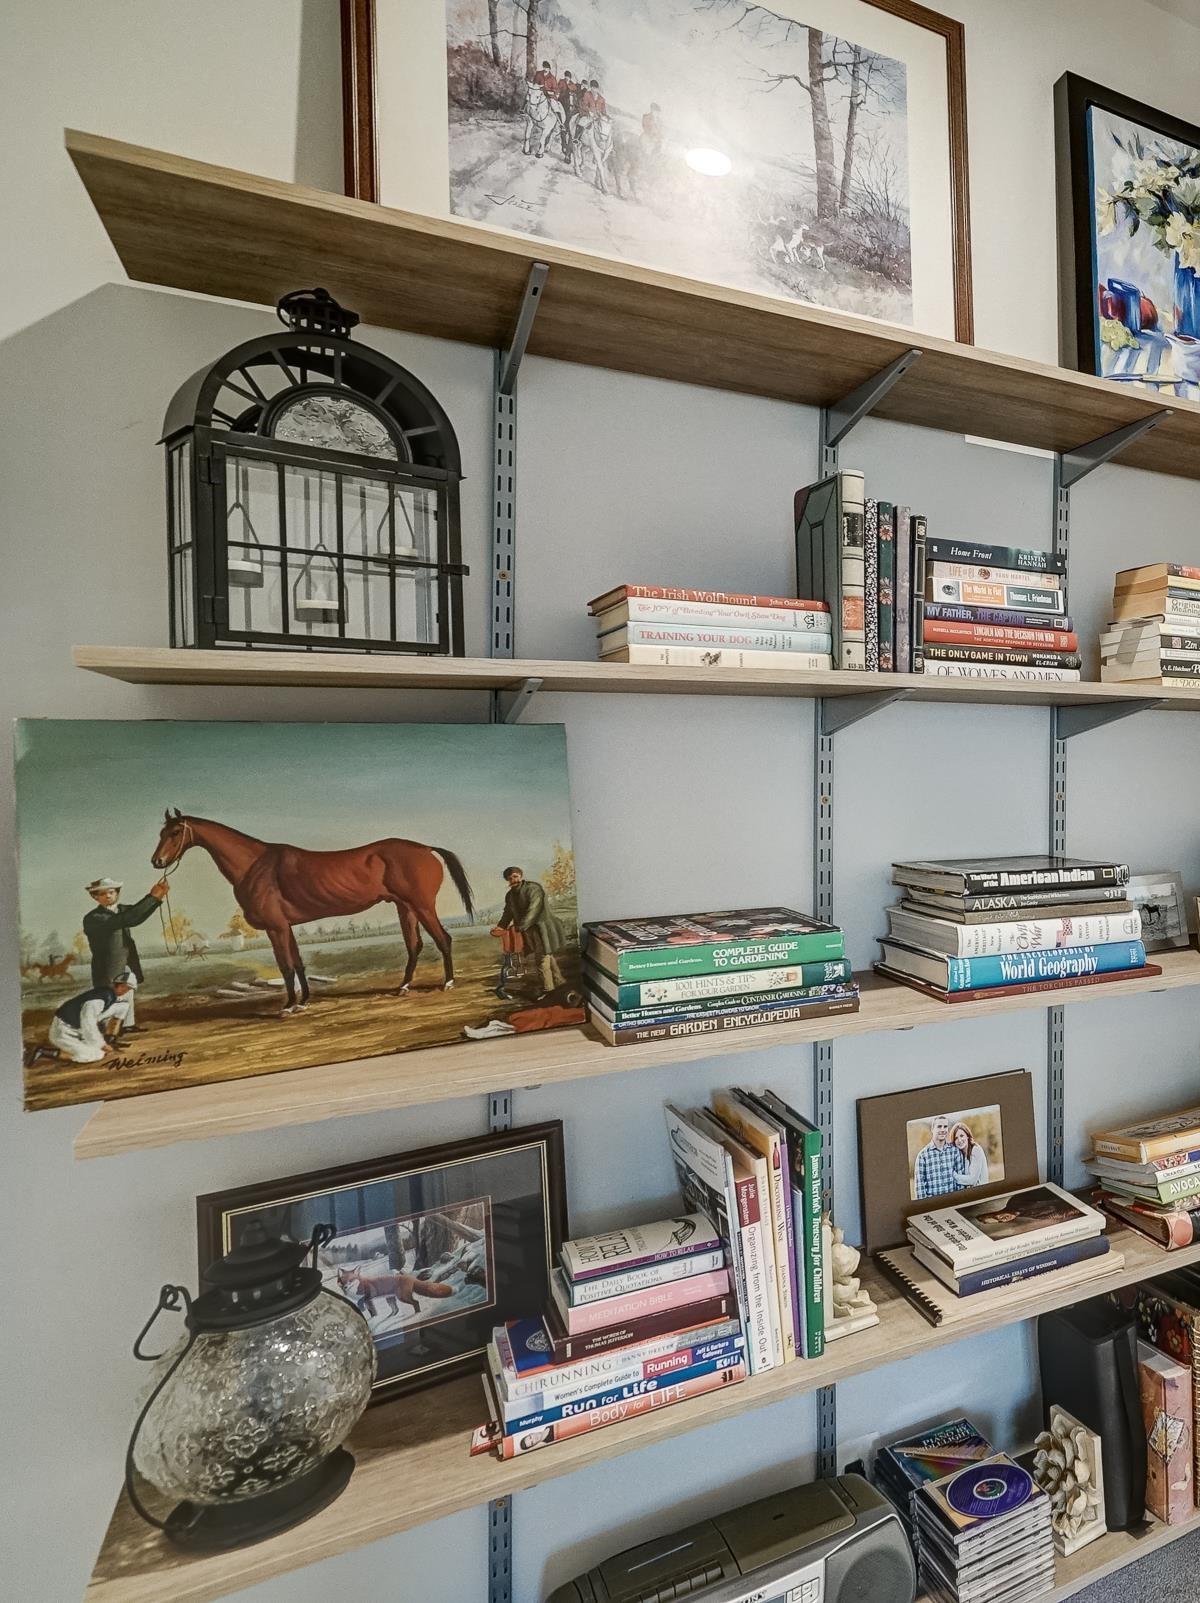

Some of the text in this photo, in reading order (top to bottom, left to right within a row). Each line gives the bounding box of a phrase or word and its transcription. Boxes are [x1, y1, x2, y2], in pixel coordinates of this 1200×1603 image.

[950, 546, 992, 560] Home Front
[1018, 554, 1046, 562] KRISTIN
[1018, 560, 1047, 568] HANNAH
[633, 585, 758, 606] The Irish Wolfhound
[769, 598, 804, 608] John Gordon
[1010, 592, 1027, 601] Thomas
[926, 606, 1025, 624] MY FATHER, THE CAPTAIN
[640, 630, 694, 642] TRAINING
[697, 634, 726, 644] YOUR
[728, 634, 752, 644] DOG
[974, 626, 994, 637] LINCOLN
[994, 628, 1004, 638] AND
[1004, 628, 1014, 638] THE
[1044, 632, 1054, 642] WAR
[1184, 640, 1198, 650] Zen
[930, 648, 1028, 663] THE ONLY GAME IN TOWN
[937, 665, 1063, 681] OF WOLVES AND MEN
[1000, 868, 1096, 887] American Indian
[972, 898, 1018, 911] ALASKA
[1031, 922, 1042, 950] War
[712, 942, 798, 958] COMPLETE GUIDE
[1021, 948, 1078, 960] ENCYCLOPEDIA
[628, 958, 678, 970] Better Homes and
[713, 951, 788, 967] TO GARDENING
[1000, 952, 1099, 980] World Geography
[675, 974, 756, 990] 1001 HINTS & TIPS
[1040, 982, 1060, 992] TORCH
[1064, 980, 1071, 988] IS
[1074, 976, 1100, 987] PASSED
[681, 984, 750, 998] FOR YOUR GARDEN
[740, 989, 806, 1005] CONTAINER GARDENING
[622, 1011, 640, 1019] Better
[641, 1008, 663, 1017] Homes
[664, 1006, 675, 1014] and
[617, 1018, 655, 1028] ORTHO BOOKS
[636, 1008, 800, 1039] THE NEW GARDEN ENCYCLOPEDIA
[748, 1183, 756, 1200] Julie
[774, 1174, 783, 1220] DISCOVERING
[740, 1185, 750, 1226] Morgenstern
[776, 1221, 785, 1242] WINE
[810, 1154, 823, 1304] James Herriot's Treasury for Children
[654, 1253, 668, 1261] HOW
[677, 1246, 695, 1255] RELAX
[981, 1272, 1010, 1286] HISTORICAL
[1011, 1268, 1028, 1278] ESSAYS
[1036, 1260, 1058, 1270] WINDSOR
[580, 1276, 663, 1302] POSITIVE QUOTATIONS
[583, 1273, 648, 1293] THE DAILY BOOK
[748, 1226, 768, 1354] Organizing from the Inside Out
[588, 1292, 673, 1320] MEDITATION BIBLE
[585, 1332, 634, 1350] THOMAS JEFFERSON
[696, 1342, 729, 1356] Jeff Barbara
[514, 1358, 612, 1396] CHIRUNNING
[554, 1353, 688, 1400] Women's Complete Guide to Running
[519, 1375, 658, 1427] Murphy Run for Life
[590, 1382, 688, 1426] Body for LIFE
